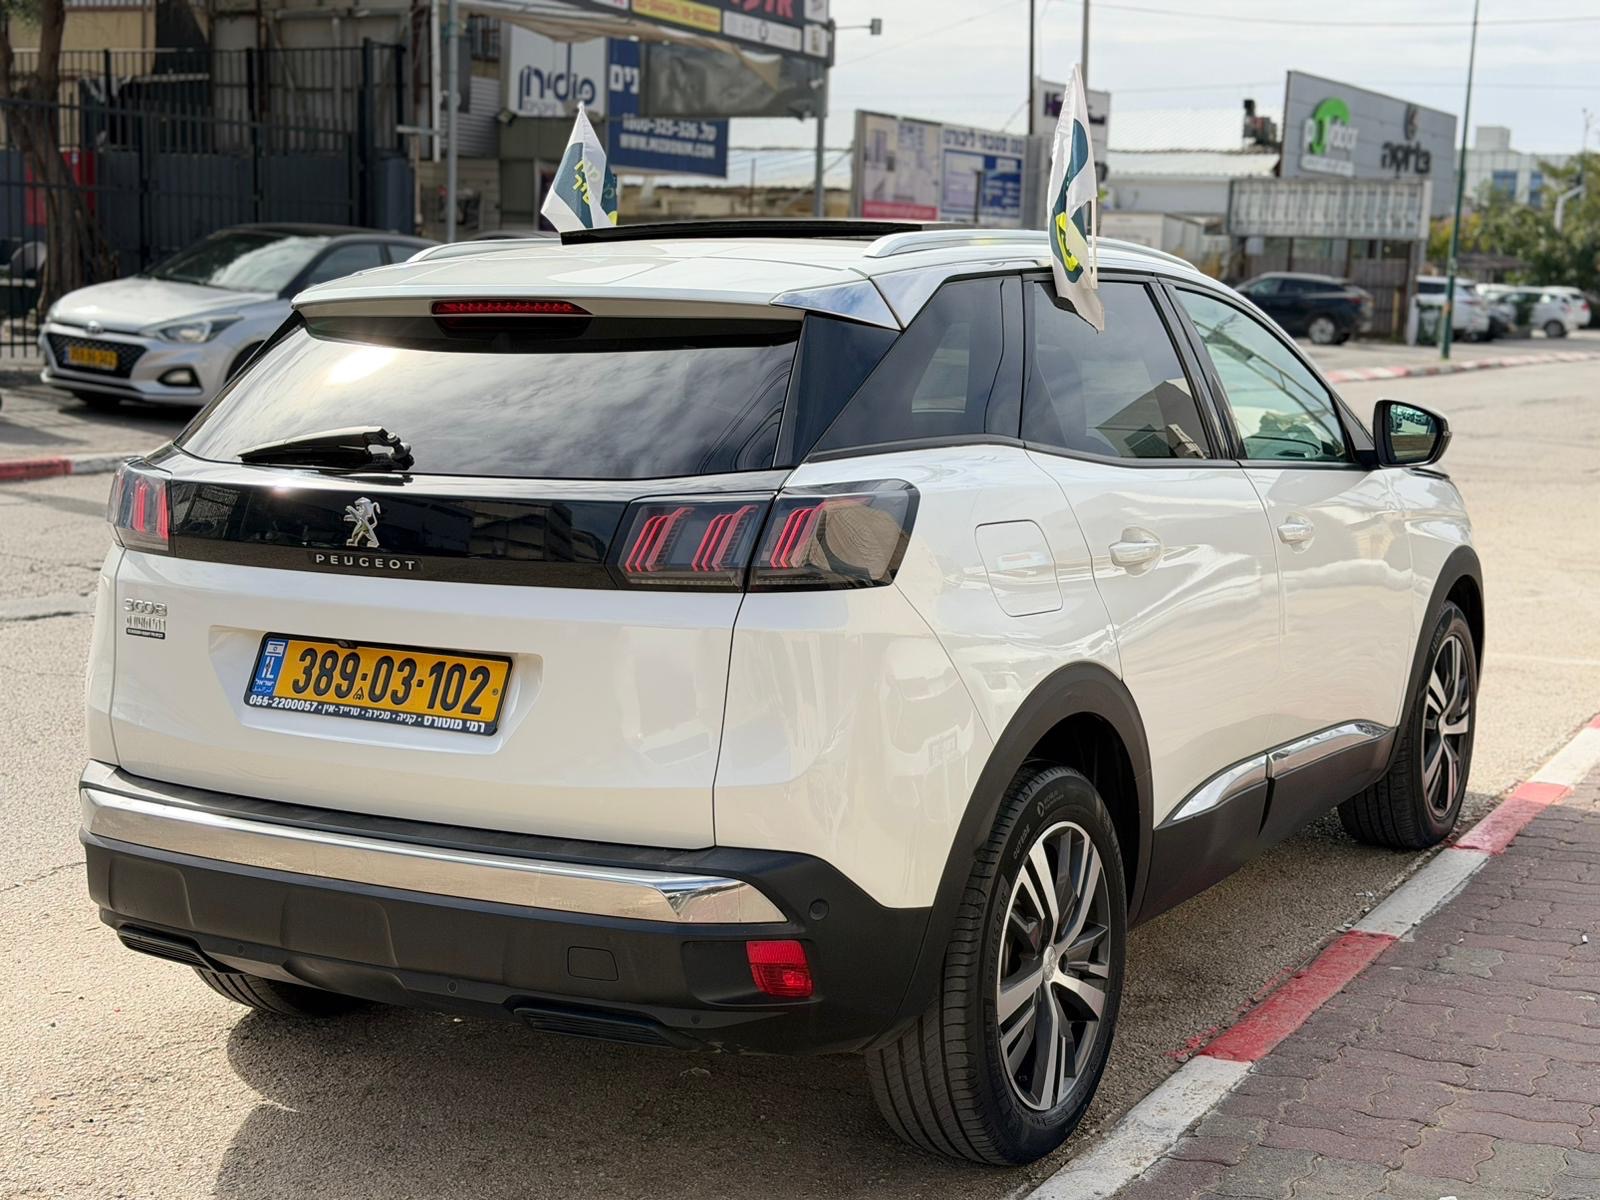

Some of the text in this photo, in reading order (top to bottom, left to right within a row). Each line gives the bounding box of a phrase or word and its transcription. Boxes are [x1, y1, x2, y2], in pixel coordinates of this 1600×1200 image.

[316, 554, 416, 570] PEUGEOT
[262, 656, 275, 679] IL
[249, 694, 318, 711] 055-2200057
[422, 715, 463, 730] מוטורס
[464, 722, 485, 733] רמי
